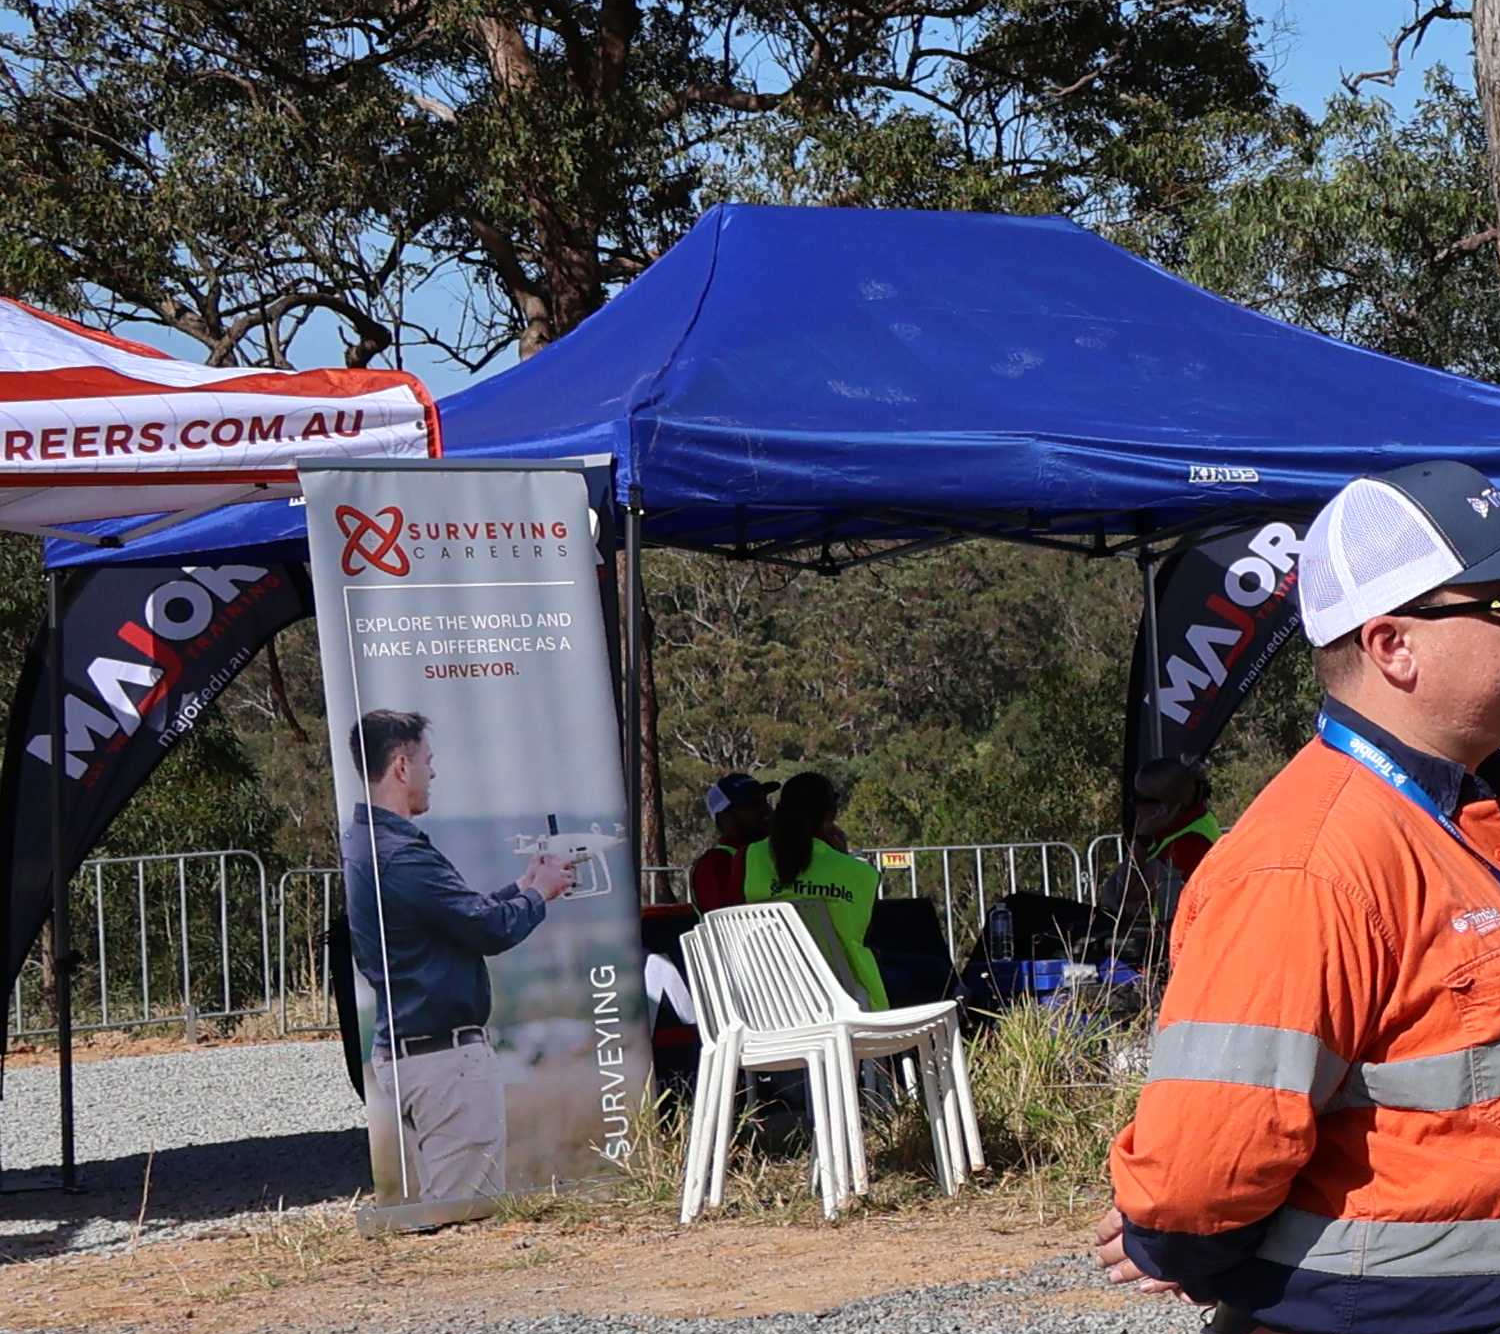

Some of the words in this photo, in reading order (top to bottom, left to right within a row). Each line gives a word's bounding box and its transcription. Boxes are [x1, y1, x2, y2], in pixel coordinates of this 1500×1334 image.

[1188, 465, 1259, 483] KINGS
[407, 521, 568, 540] SURVEYING
[413, 545, 568, 561] CAREERS
[356, 615, 433, 635] EXPLORE
[435, 614, 469, 632] THE
[470, 612, 534, 630] WORLD
[535, 611, 572, 628] AND
[1143, 522, 1304, 725] MAJOR
[362, 640, 413, 658] MAKE
[415, 639, 429, 657] A
[430, 637, 533, 657] DIFFERENCE
[535, 636, 557, 652] AS
[558, 636, 572, 652] A
[423, 661, 520, 681] SURVEYOR.
[1349, 736, 1397, 777] Trimble
[589, 964, 632, 1160] SURVEYING
